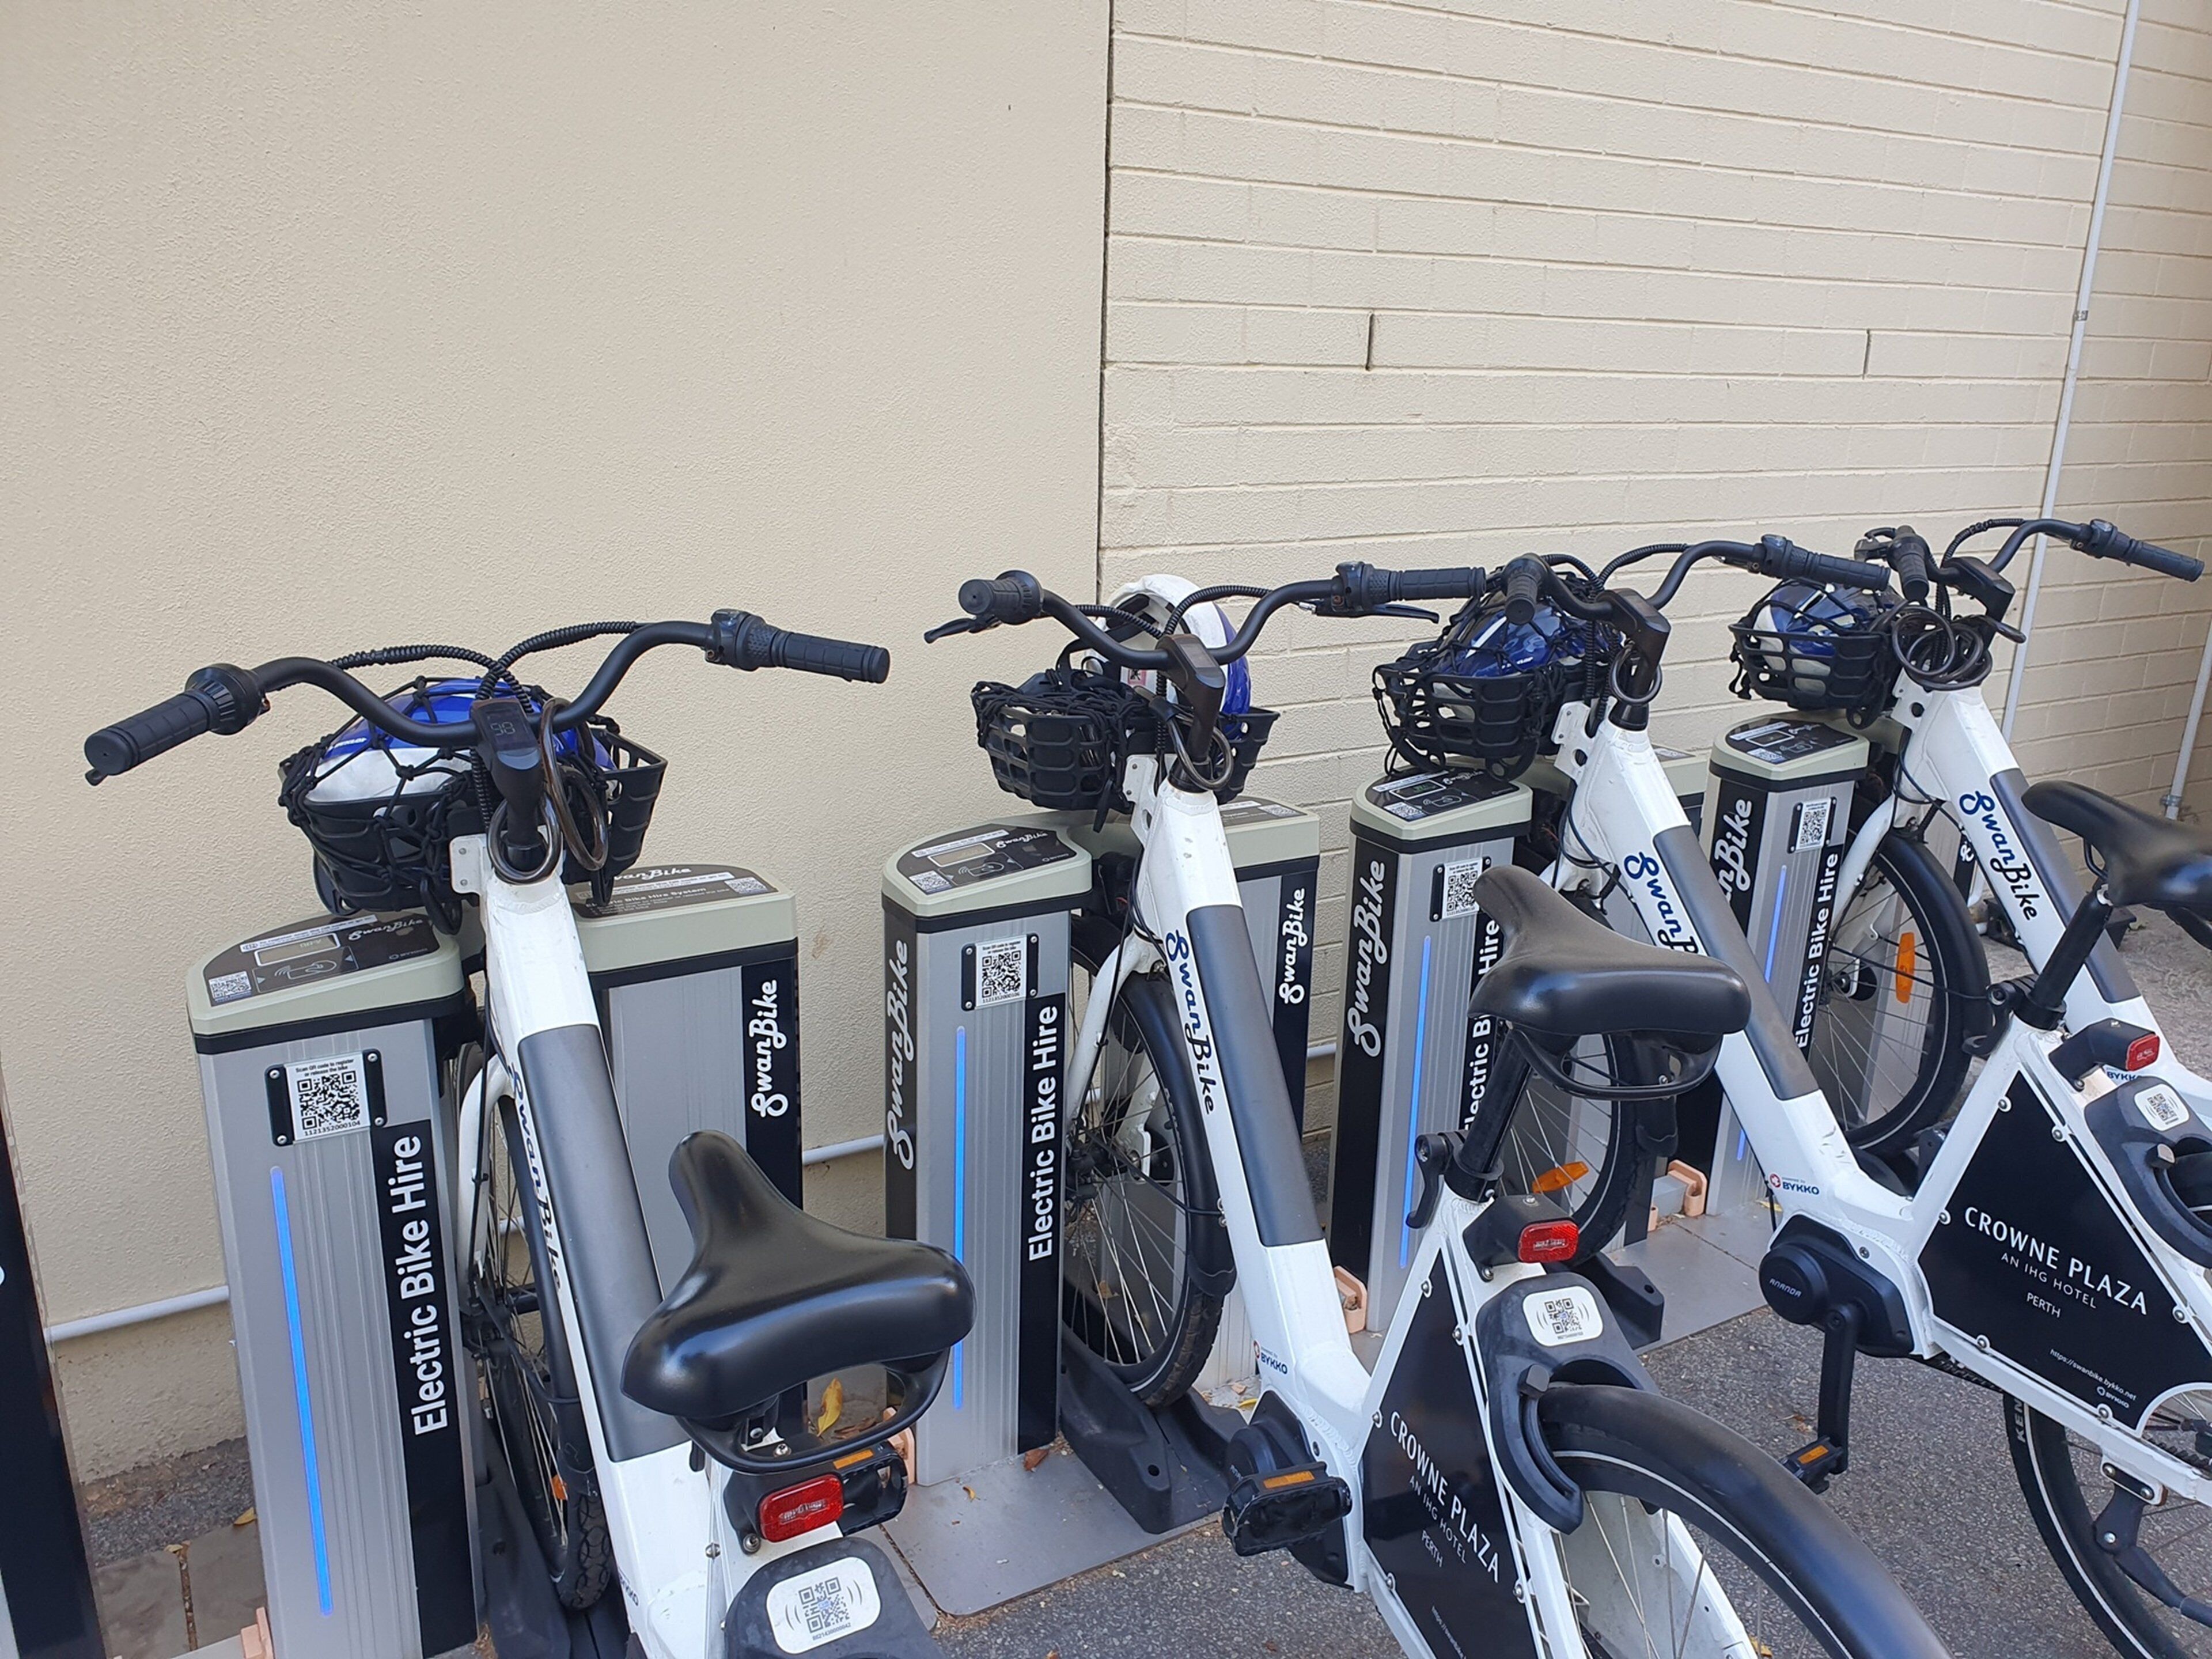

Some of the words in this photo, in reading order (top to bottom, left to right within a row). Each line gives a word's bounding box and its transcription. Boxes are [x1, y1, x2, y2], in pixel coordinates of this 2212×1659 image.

[490, 721, 515, 736] 98
[1715, 799, 1752, 901] nBike
[1817, 853, 1839, 903] Hire
[1959, 791, 2040, 921] SwanBike
[348, 919, 423, 941] SwanBike
[1624, 851, 1699, 954] SwanB
[1809, 907, 1830, 960] Bike
[1279, 888, 1309, 1005] SwanBike
[1348, 860, 1388, 1057] SwanBike
[1033, 1006, 1058, 1071] Hire
[1165, 929, 1217, 1115] SwanBike
[1463, 1043, 1489, 1131] lectric
[1479, 920, 1500, 975] Hire
[1796, 963, 1820, 1048] Electric
[749, 979, 789, 1118] SwanBike
[887, 940, 914, 1170] SwanBike
[2107, 1071, 2138, 1081] BYKK
[304, 1120, 361, 1136] 1121352000104
[1032, 1076, 1057, 1144] Bike
[388, 1136, 426, 1213] Hire
[1028, 1149, 1055, 1261] Electric
[1782, 1181, 1820, 1195] BYKKO
[396, 1219, 435, 1300] Bike
[1965, 1206, 2060, 1270] CROWNE
[2068, 1257, 2147, 1316] PLAZA
[2001, 1252, 2020, 1268] AN
[2024, 1263, 2047, 1282] IHG
[2053, 1278, 2097, 1309] HOTEL
[2027, 1292, 2061, 1318] PERTH
[404, 1305, 448, 1435] Electric
[1260, 1351, 1288, 1374] BYKKO
[2050, 1349, 2137, 1401] https://swanbike.bykko.net
[2014, 1398, 2026, 1443] KEN
[1391, 1411, 1448, 1506] CROWNE
[1450, 1495, 1498, 1583] PLAZA
[1410, 1475, 1422, 1495] AN
[1423, 1494, 1438, 1520] IHG
[1440, 1518, 1467, 1563] HOTEL
[1421, 1530, 1444, 1567] PERTH
